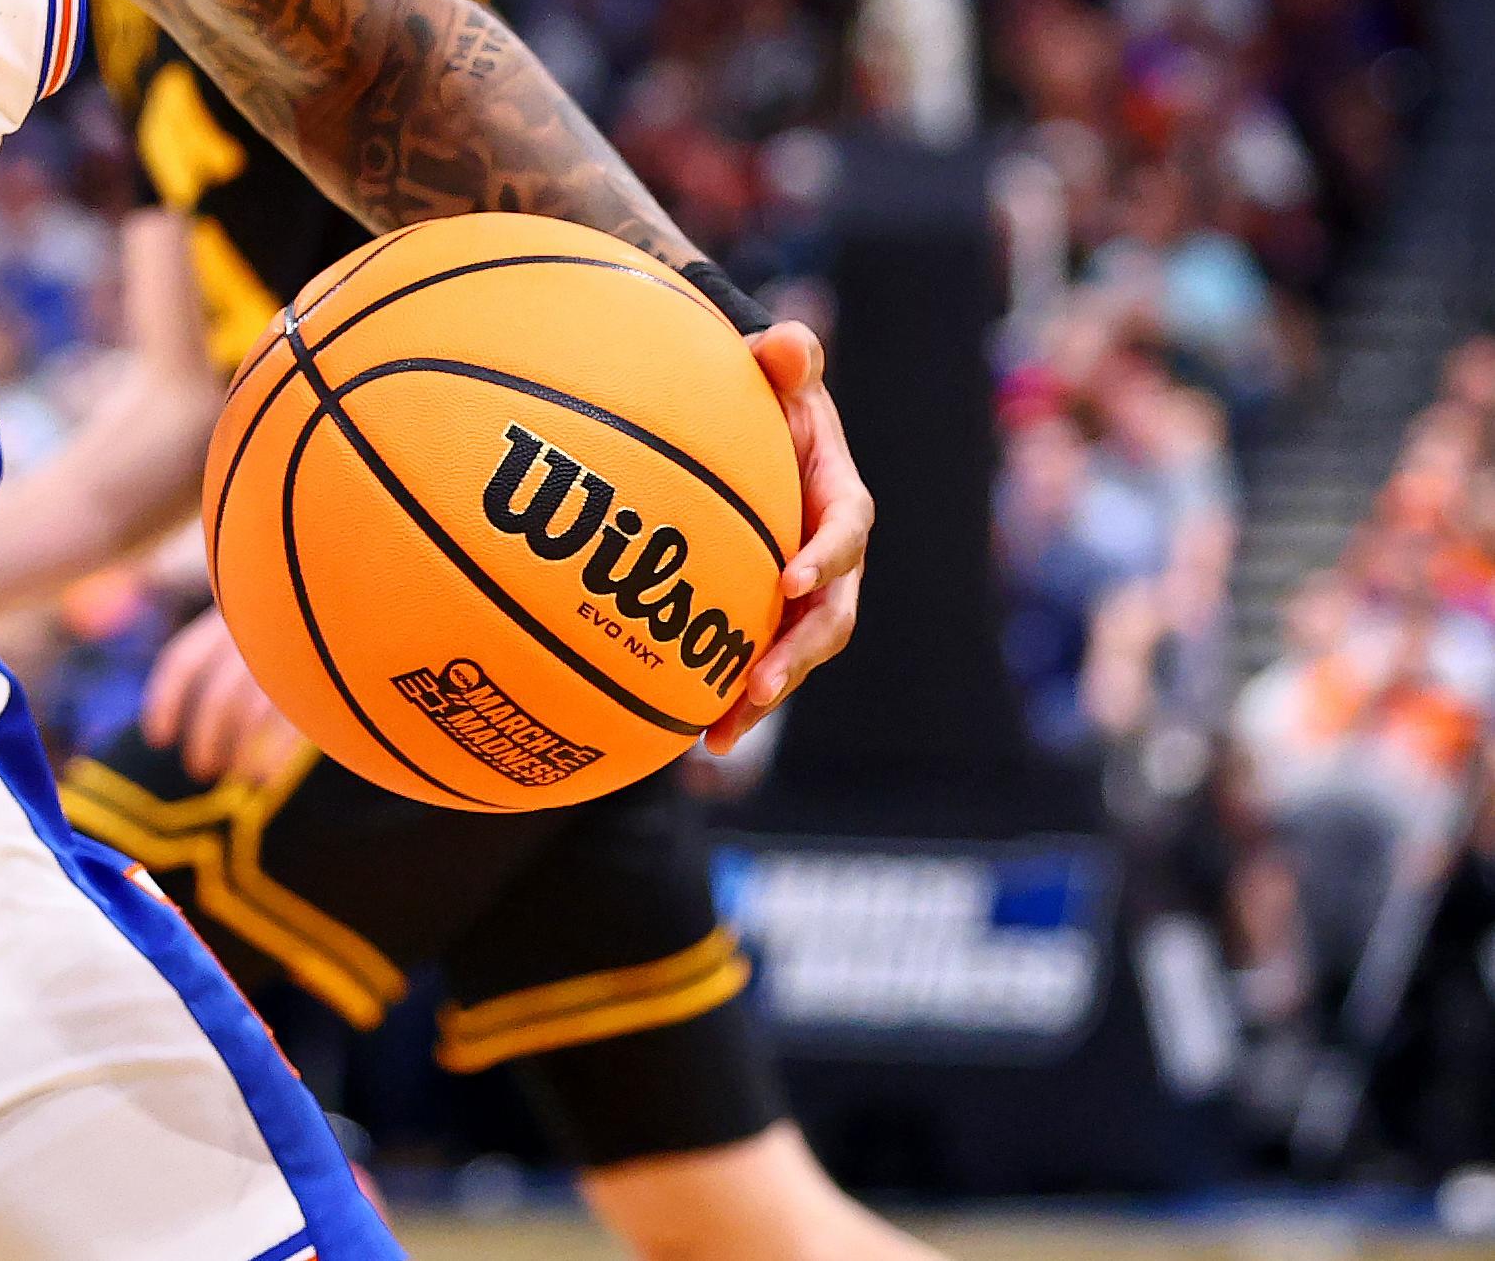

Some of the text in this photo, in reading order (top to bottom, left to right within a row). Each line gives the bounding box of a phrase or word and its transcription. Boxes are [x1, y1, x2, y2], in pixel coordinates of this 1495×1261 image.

[482, 420, 757, 697] Wilson
[577, 601, 664, 669] EVO NXT
[447, 709, 569, 786] MADNESS
[464, 684, 559, 753] MARCH
